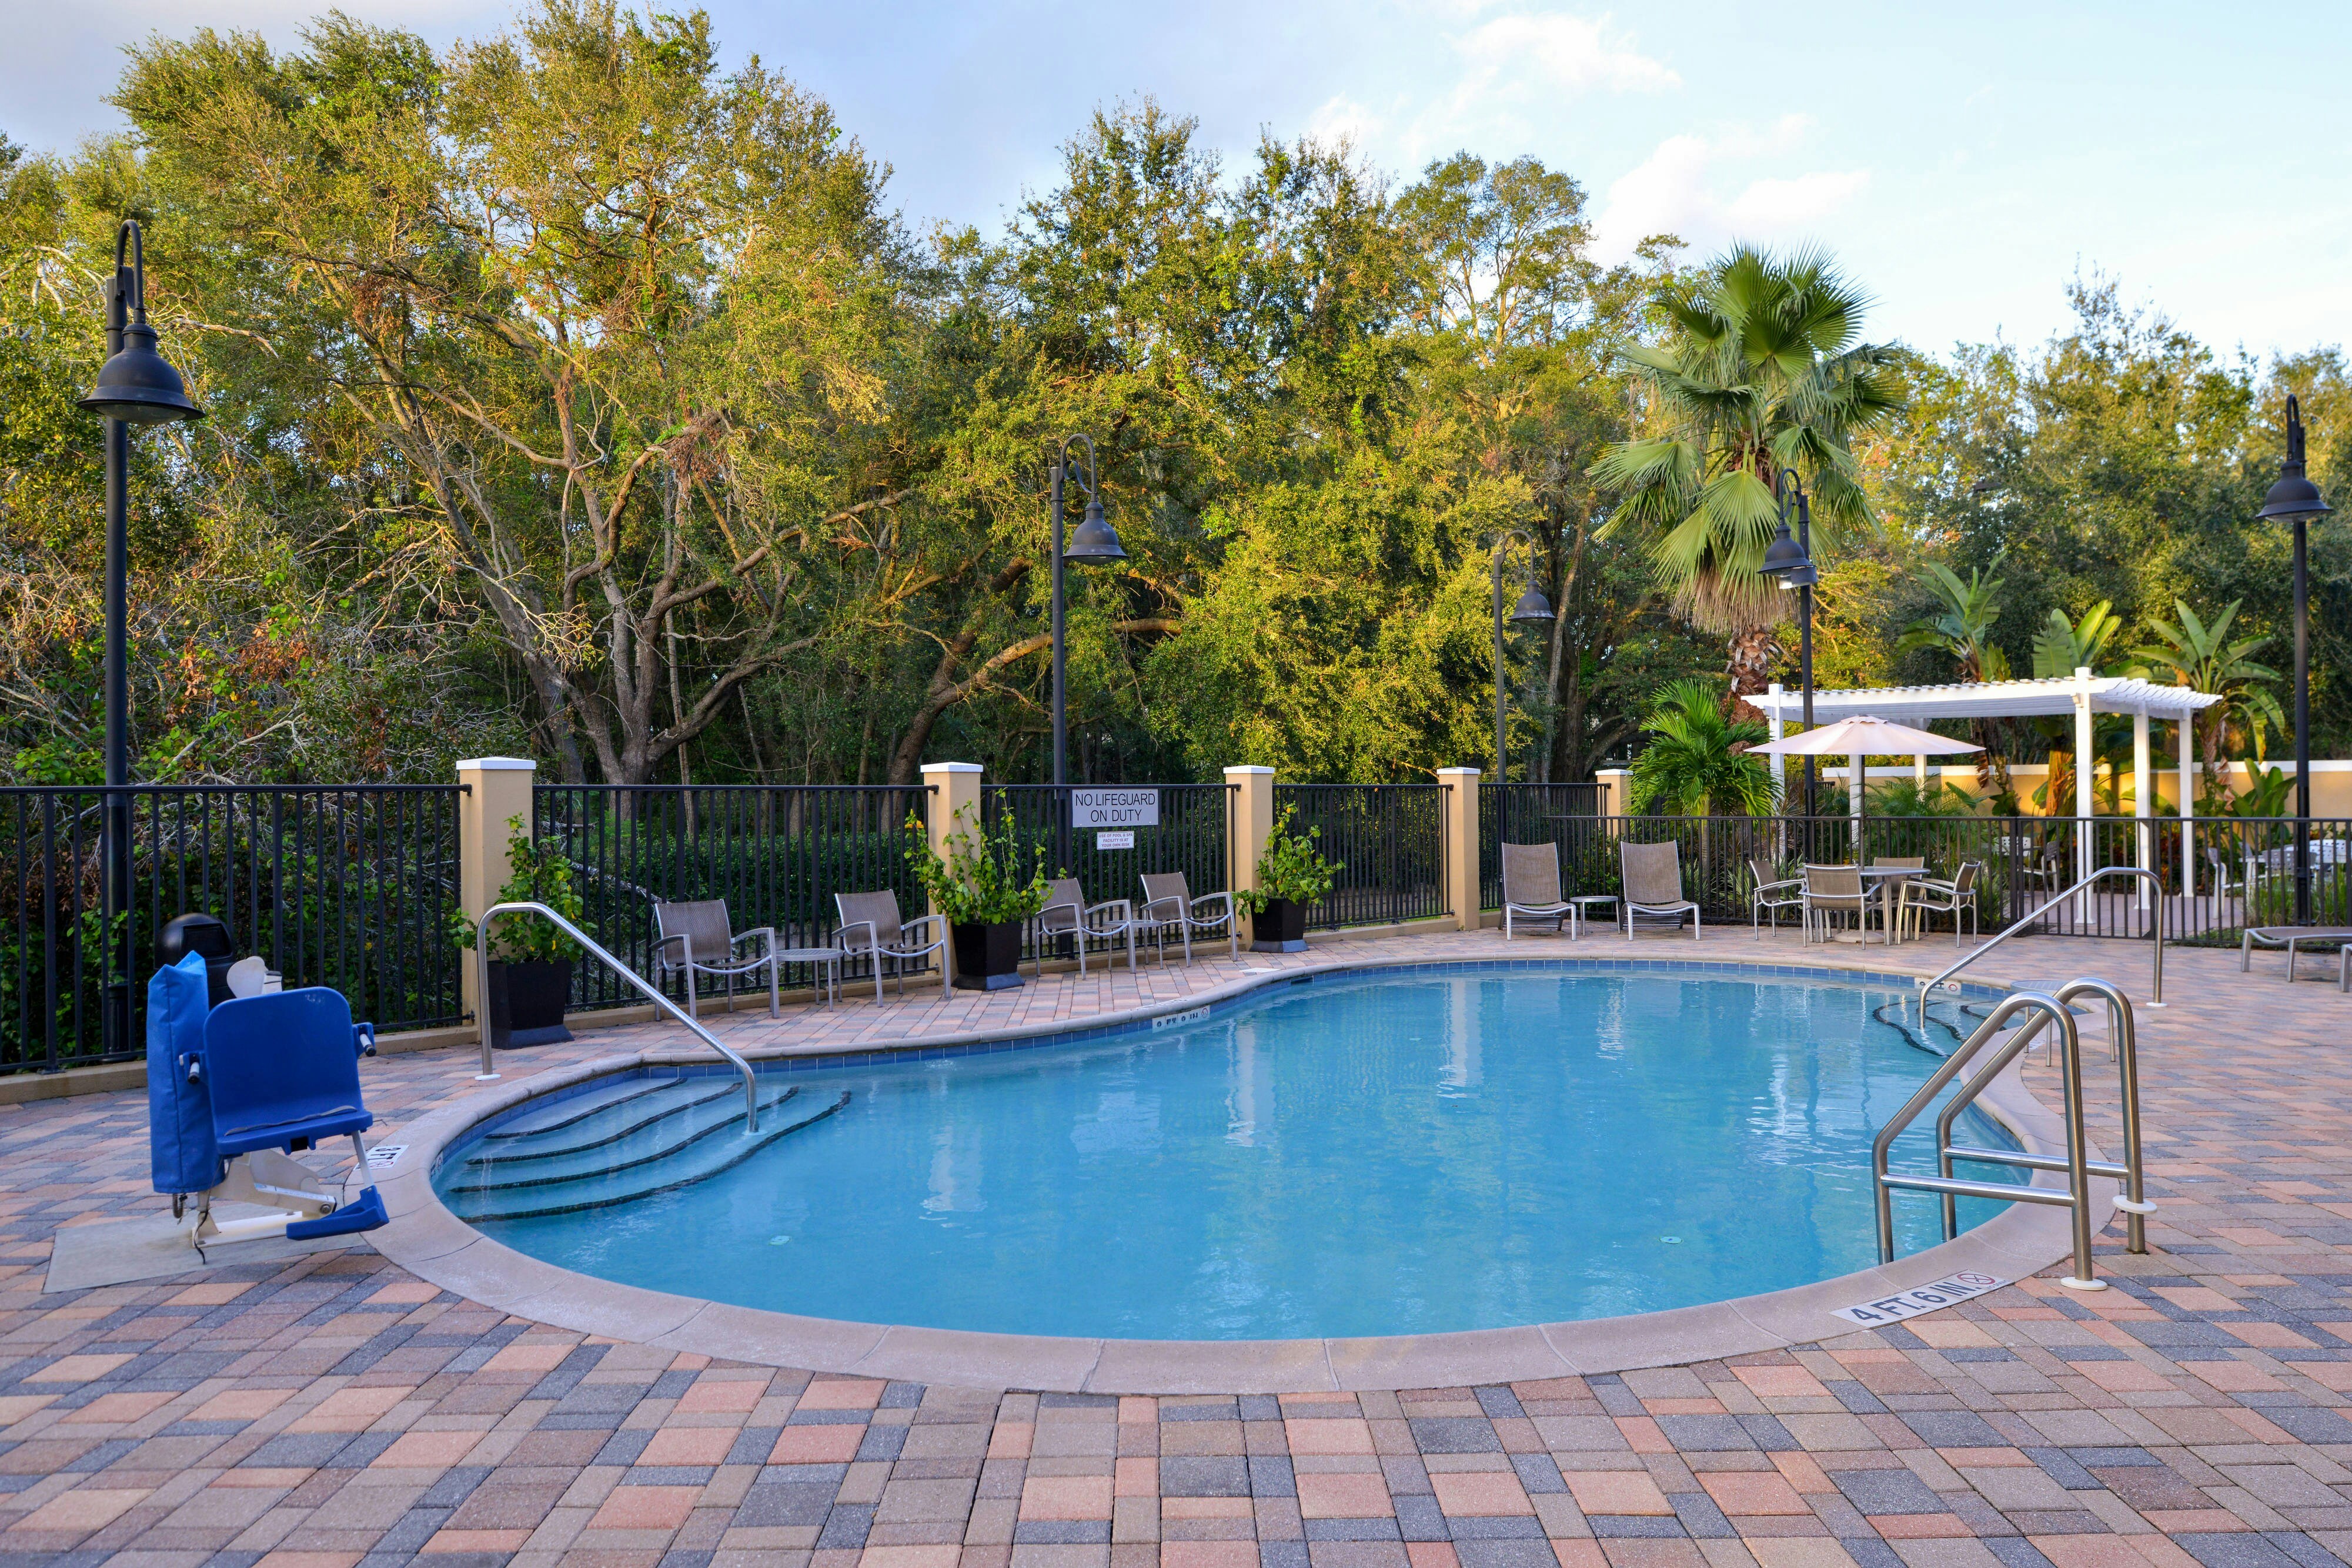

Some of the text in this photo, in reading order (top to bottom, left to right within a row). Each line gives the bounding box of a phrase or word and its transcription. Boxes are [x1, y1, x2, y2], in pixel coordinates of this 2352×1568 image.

[1075, 793, 1155, 806] NO LIFEGUARD
[1091, 809, 1142, 822] ON DUTY
[368, 1152, 397, 1161] FT
[1850, 1308, 1885, 1320] 4
[1870, 1298, 1927, 1316] FT.
[1910, 1291, 1947, 1303] 6
[1929, 1282, 1982, 1297] IN.
